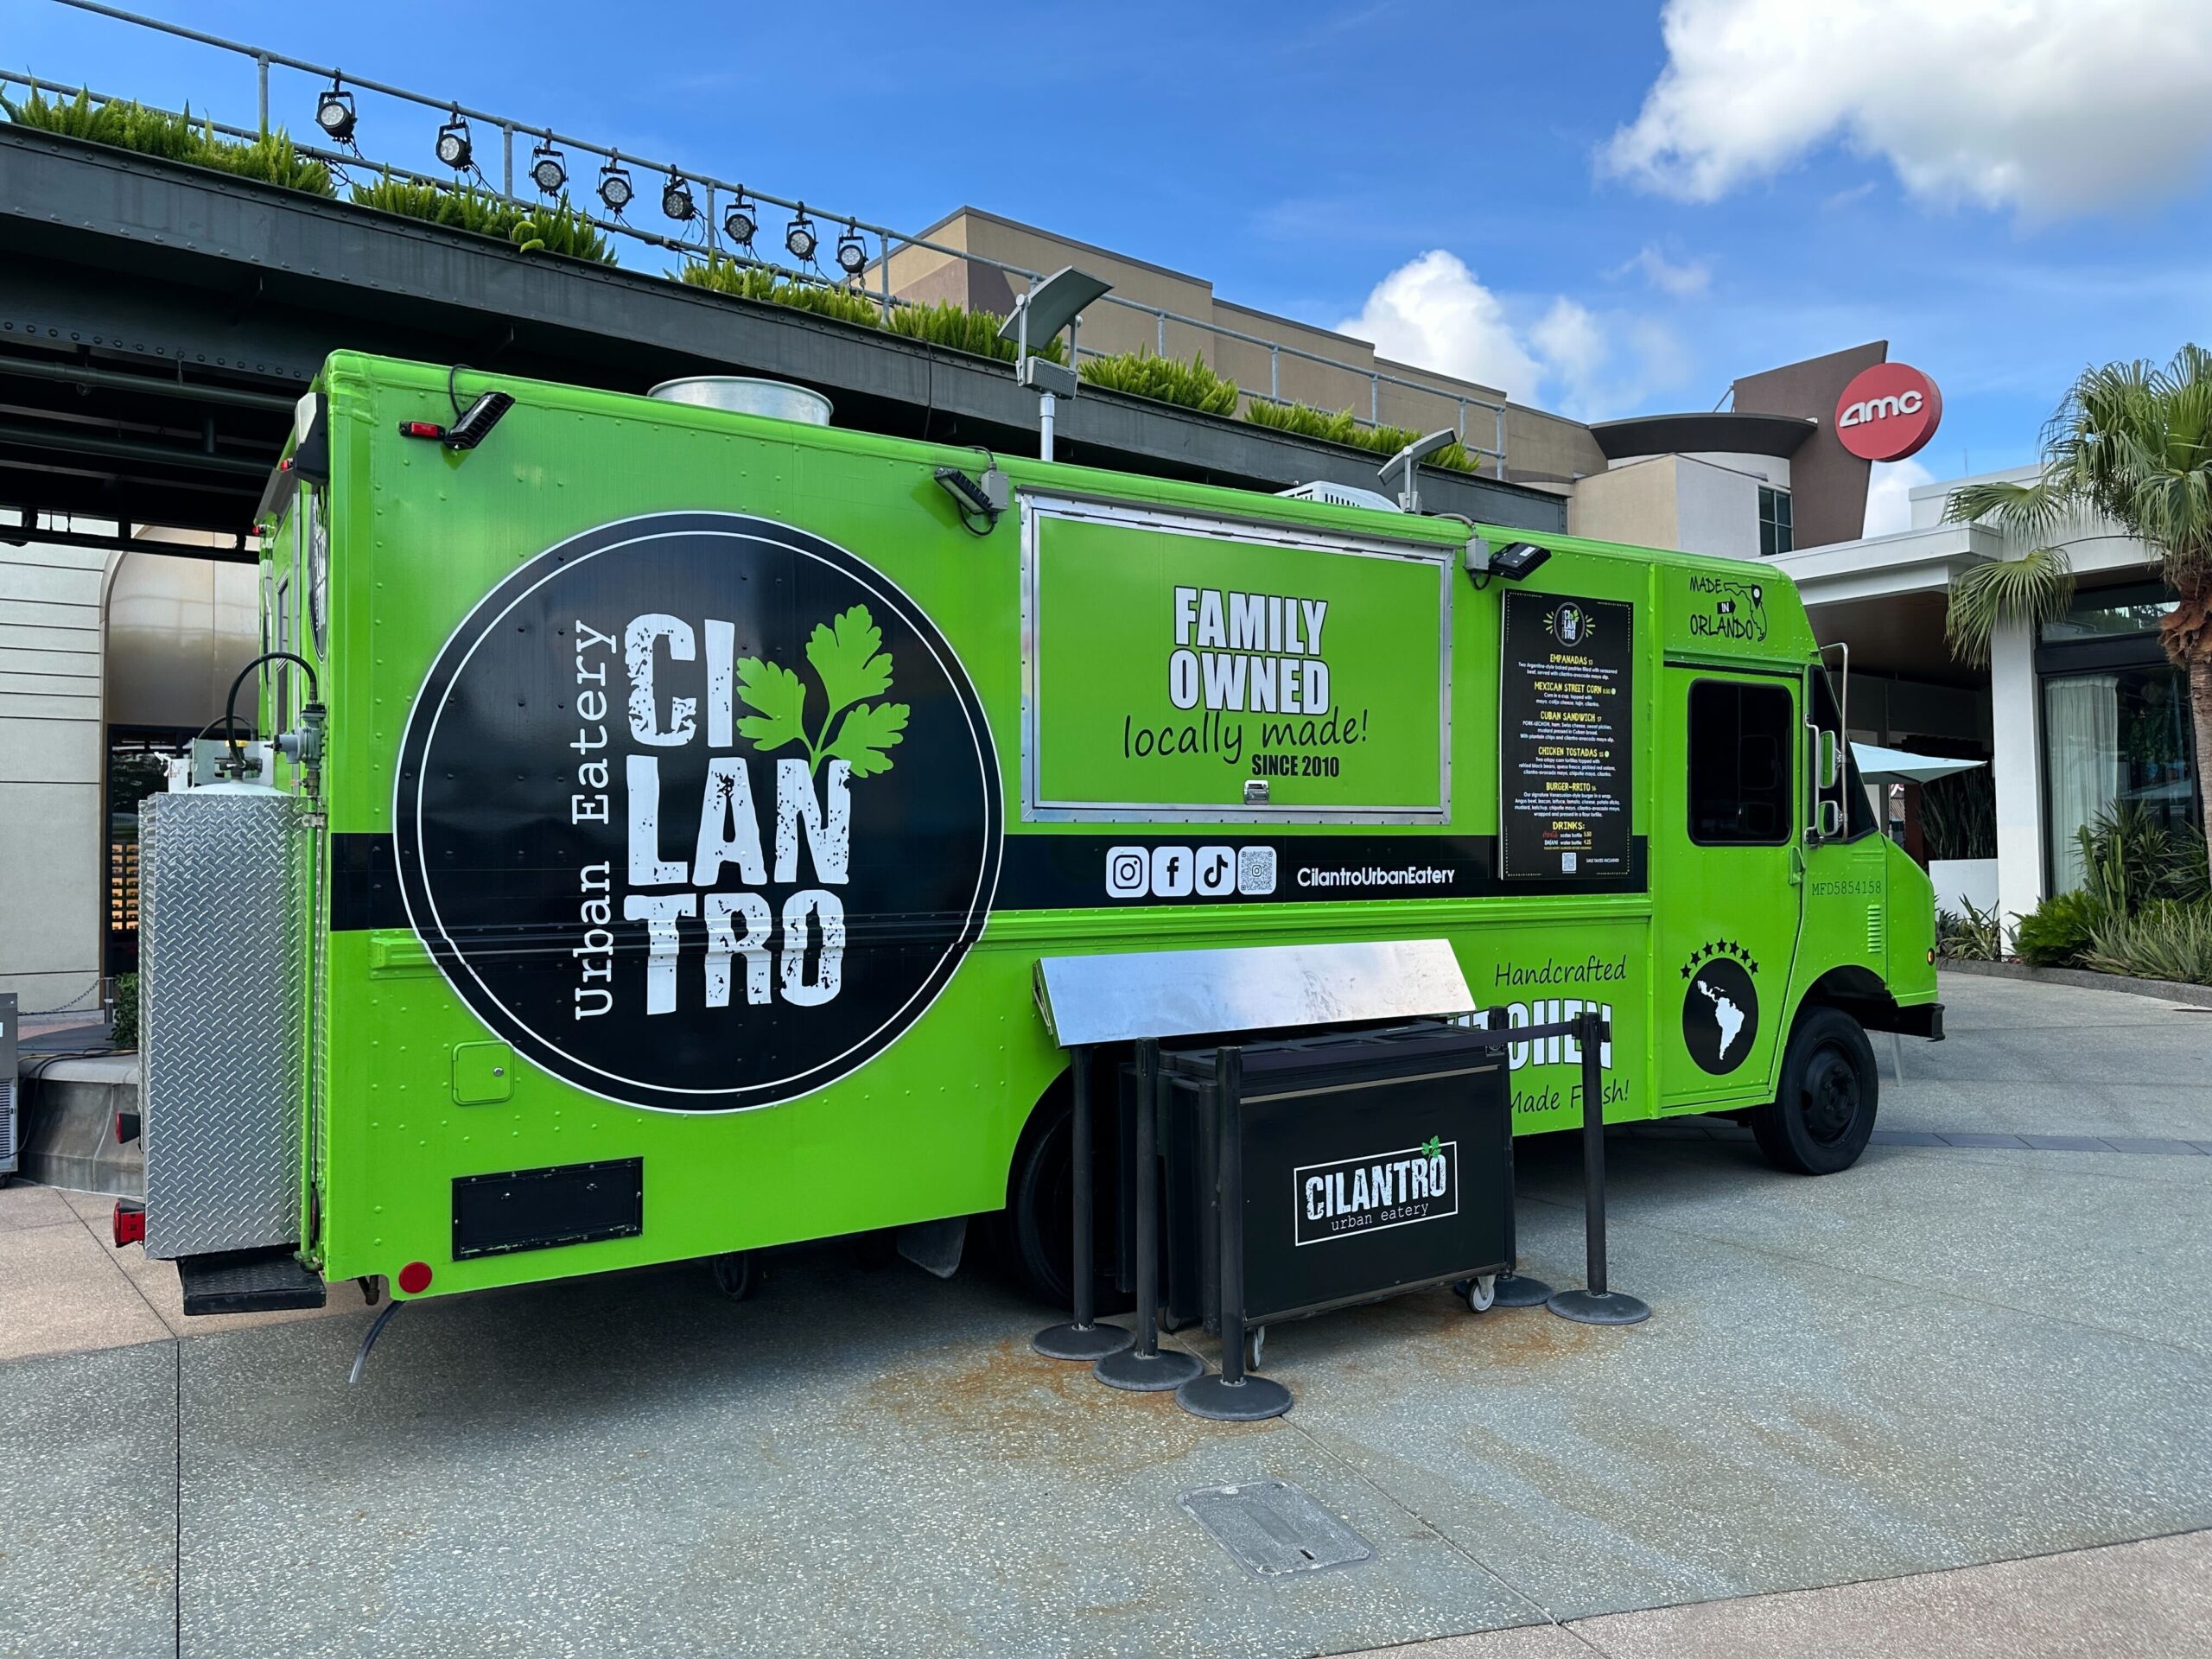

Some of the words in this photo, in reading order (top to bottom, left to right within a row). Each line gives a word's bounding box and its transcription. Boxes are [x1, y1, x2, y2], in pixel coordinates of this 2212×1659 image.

[1689, 575, 1722, 594] MADE
[1173, 585, 1328, 657] FAMILY
[1721, 602, 1730, 613] IN
[1690, 613, 1753, 640] ORLANDO
[1550, 654, 1587, 665] EMPANADAS
[624, 613, 736, 749] CI
[1168, 648, 1330, 716] OWNED
[1534, 681, 1562, 691] MEXICAN
[1564, 683, 1585, 693] STREET
[1586, 684, 1602, 694] CORN
[570, 619, 617, 826] Eatery
[1541, 711, 1560, 721] CUBAN
[1563, 712, 1595, 722] SANDWICH
[1123, 711, 1243, 765] locally
[1262, 705, 1369, 749] made!
[1251, 753, 1299, 777] SINCE
[1301, 755, 1340, 778] 2010
[1538, 747, 1563, 756] CHICKEN
[1566, 747, 1598, 757] TOSTADAS
[1546, 782, 1590, 791] BURGER-RRITO
[625, 753, 852, 887] LAN
[1296, 867, 1455, 888] CilantroUrbanEatery
[1811, 880, 1882, 896] MFD5854158
[574, 861, 613, 1020] Urban
[624, 889, 846, 1016] TRO
[1494, 954, 1627, 988] Handcrafted
[1570, 1078, 1630, 1109] Fsh!
[1305, 1154, 1446, 1221] CILANTRO
[1331, 1212, 1373, 1231] urban
[1381, 1203, 1429, 1221] eatery
